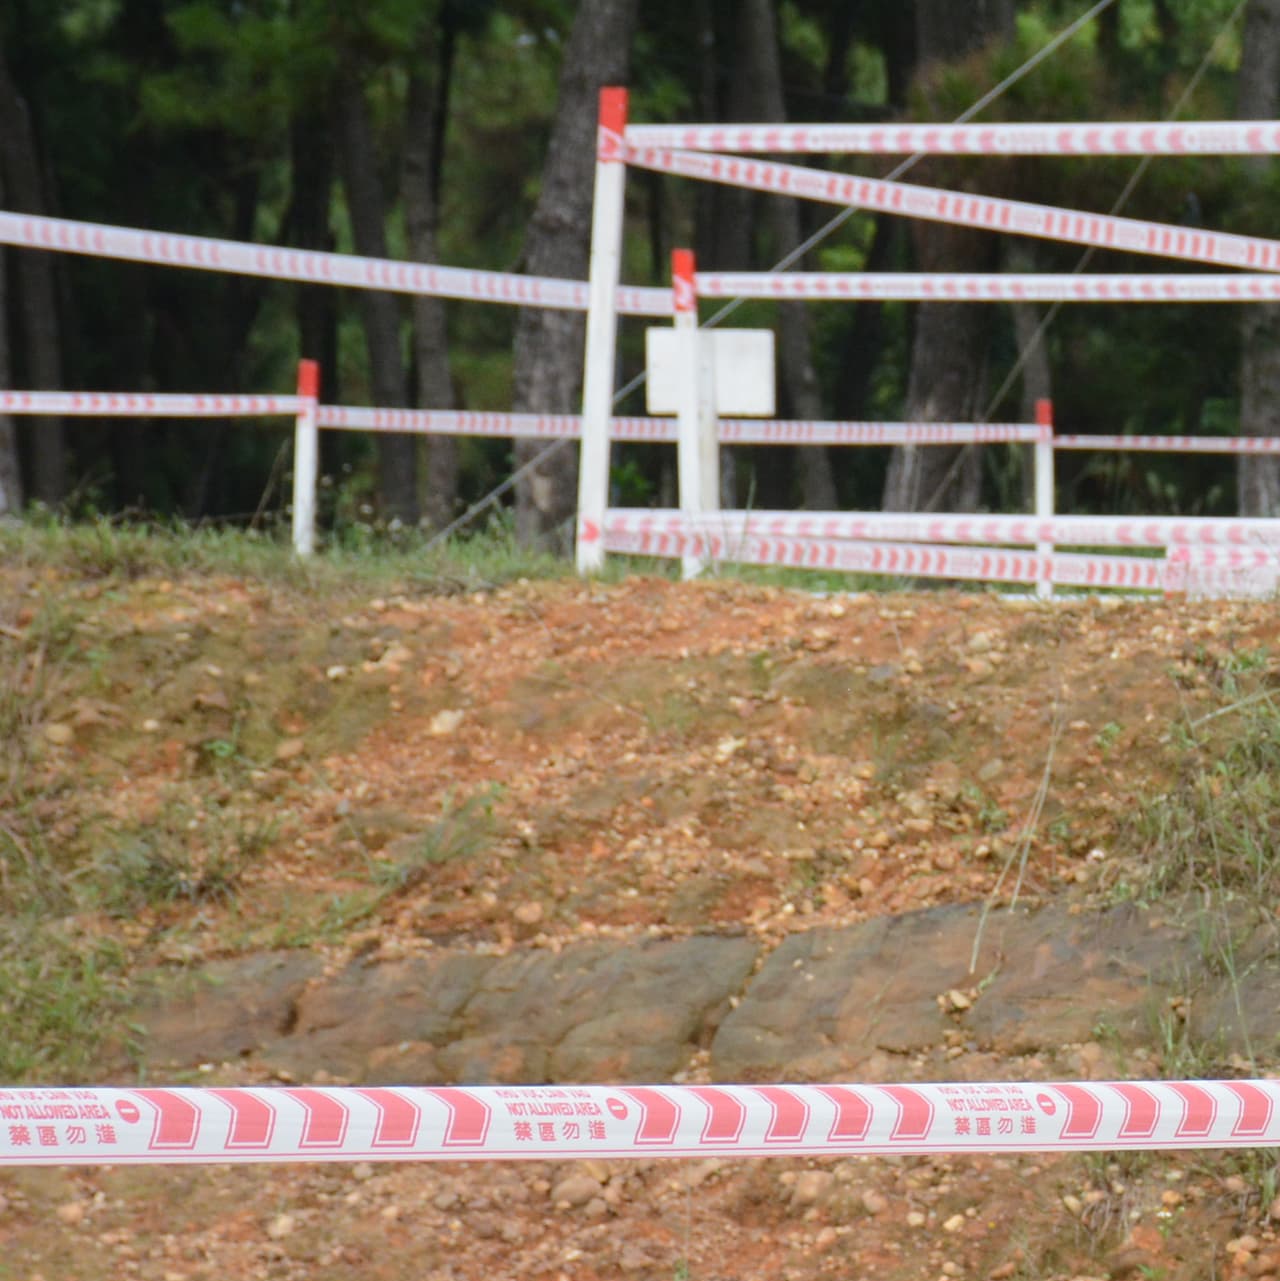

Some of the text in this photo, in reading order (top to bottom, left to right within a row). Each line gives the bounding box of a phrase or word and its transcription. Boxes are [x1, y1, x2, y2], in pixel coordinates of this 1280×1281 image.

[0, 1104, 111, 1119] NOT ALLOWED AREA
